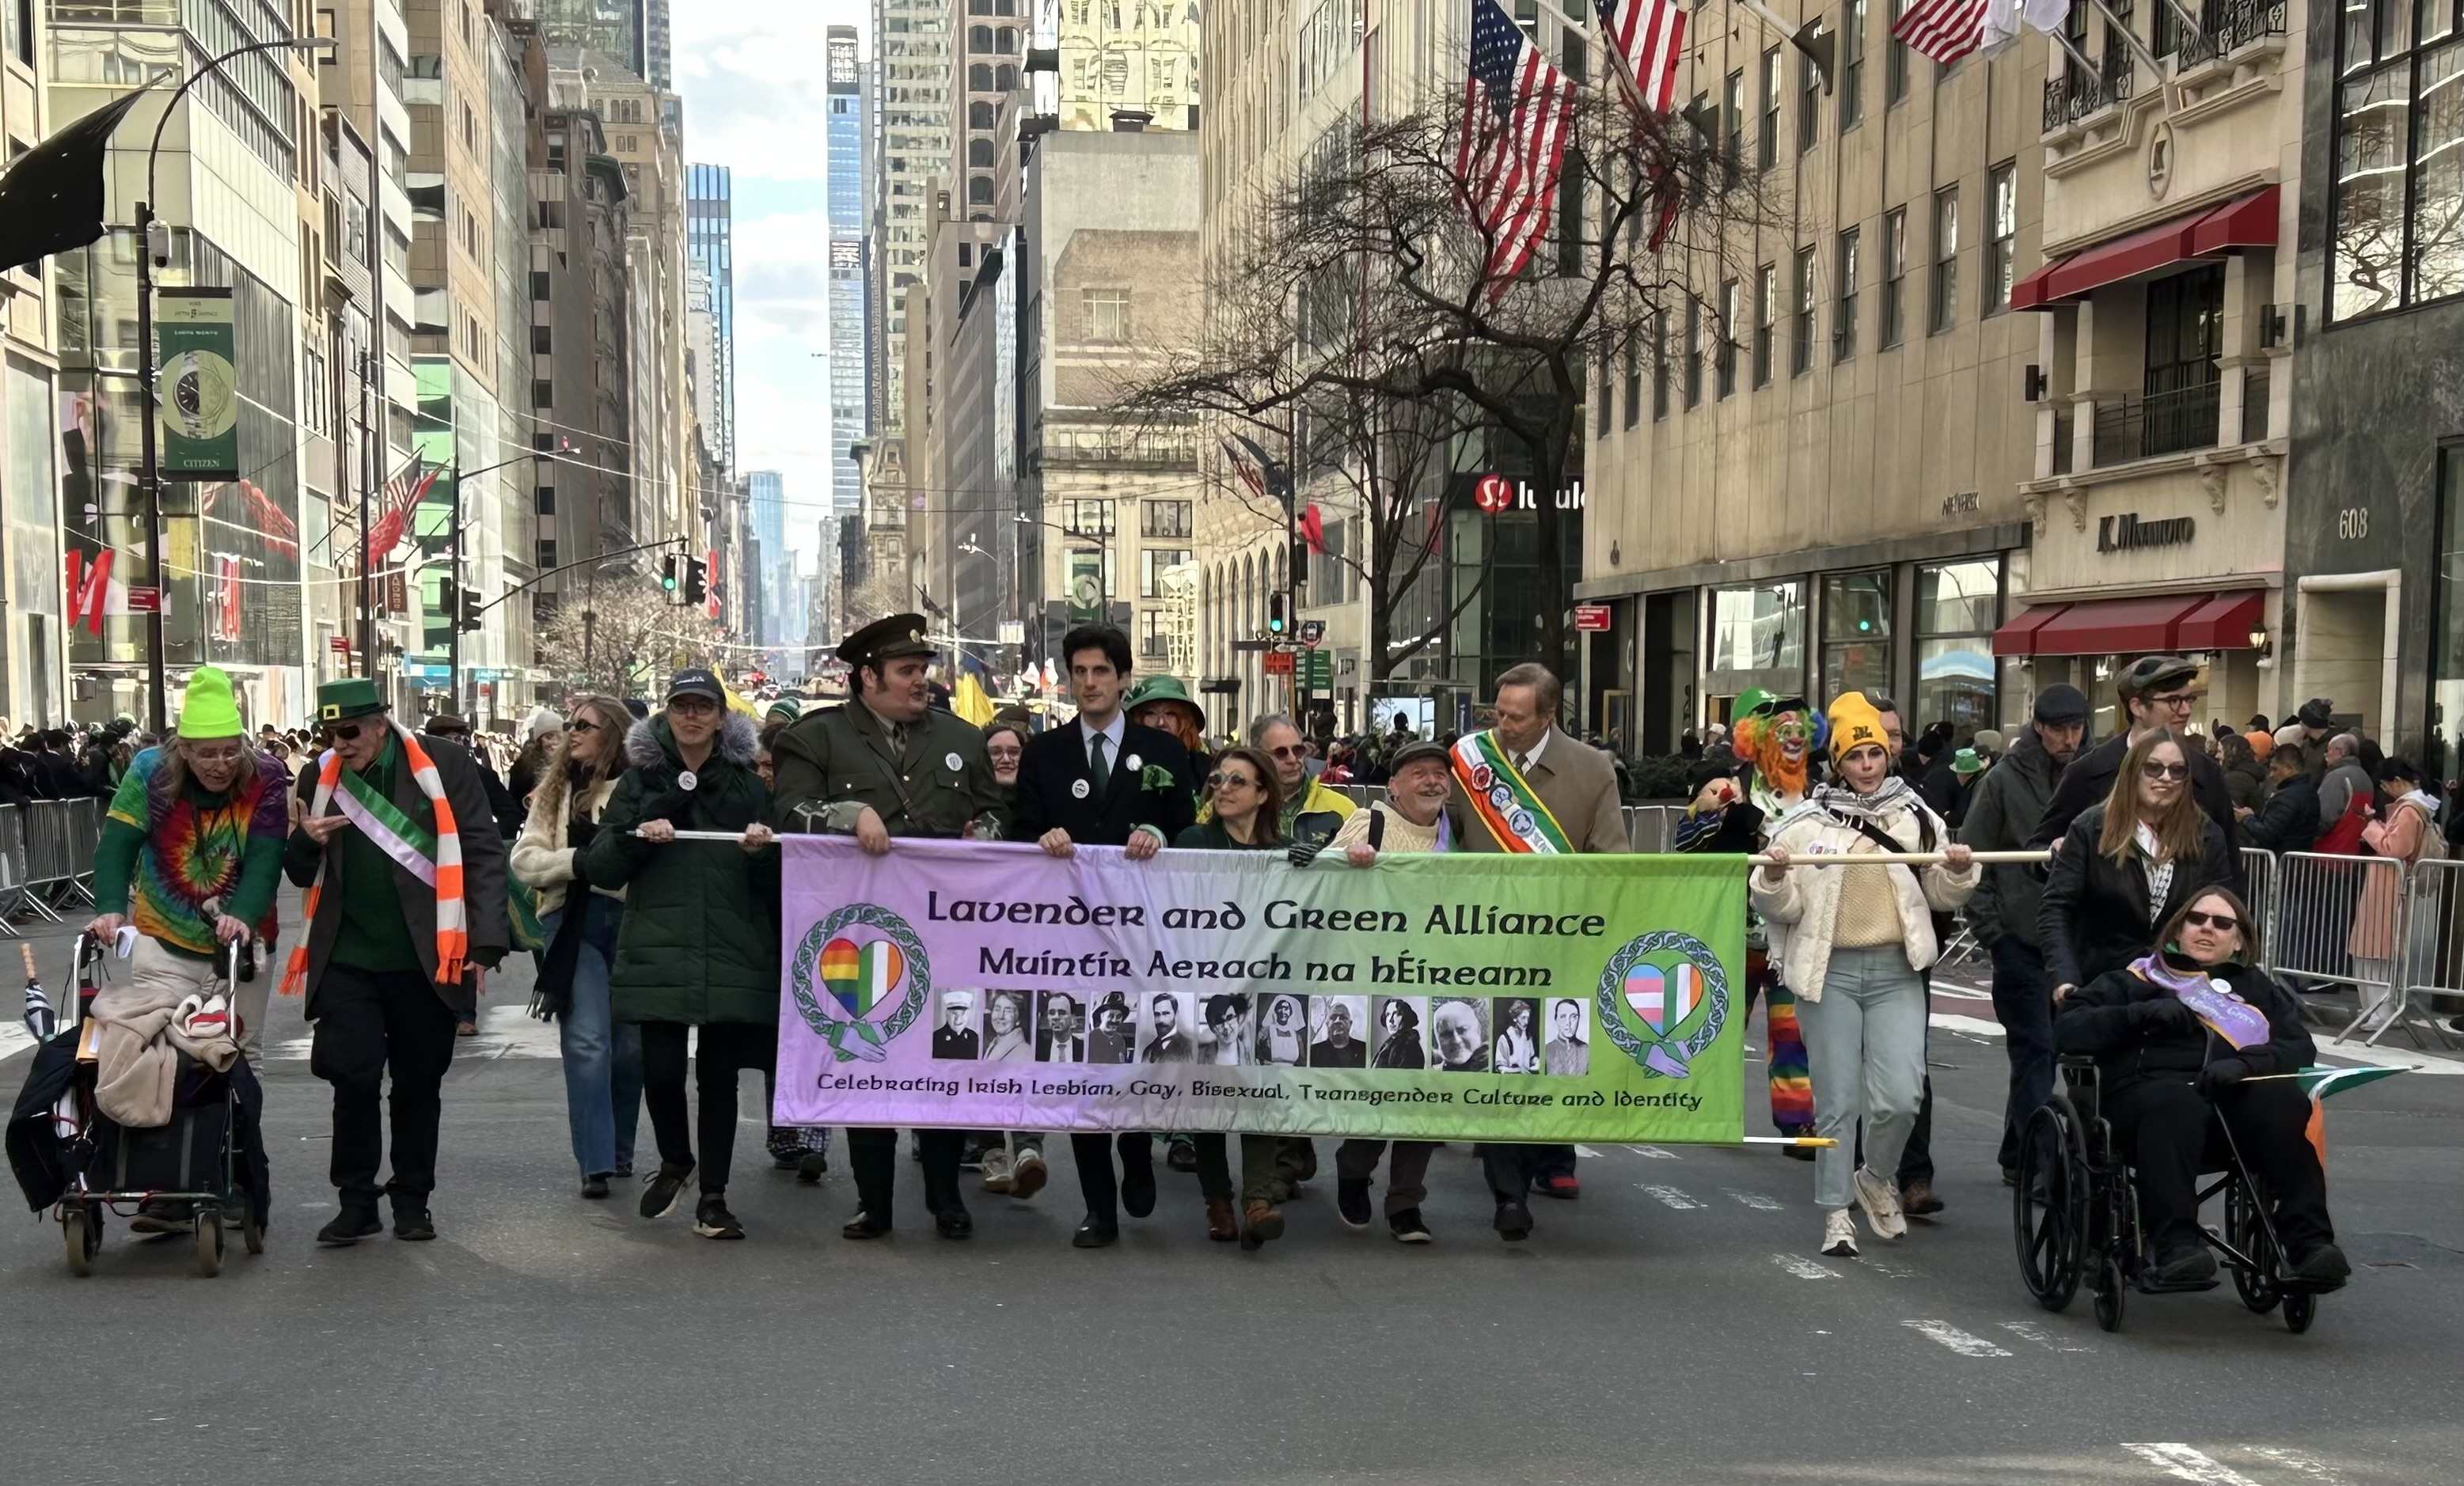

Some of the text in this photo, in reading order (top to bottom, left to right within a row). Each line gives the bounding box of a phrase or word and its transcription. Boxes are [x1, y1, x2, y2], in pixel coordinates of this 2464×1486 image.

[183, 459, 220, 468] CITIZEN
[2339, 507, 2368, 540] 608
[927, 889, 1606, 938] Lavender and Green Alliance
[978, 946, 1553, 988] Muintir Aerach na hÉireann
[816, 1072, 1704, 1113] Celebrating Irish Lesbian, Gay, Bisexual, Transgender Culture and Identity
